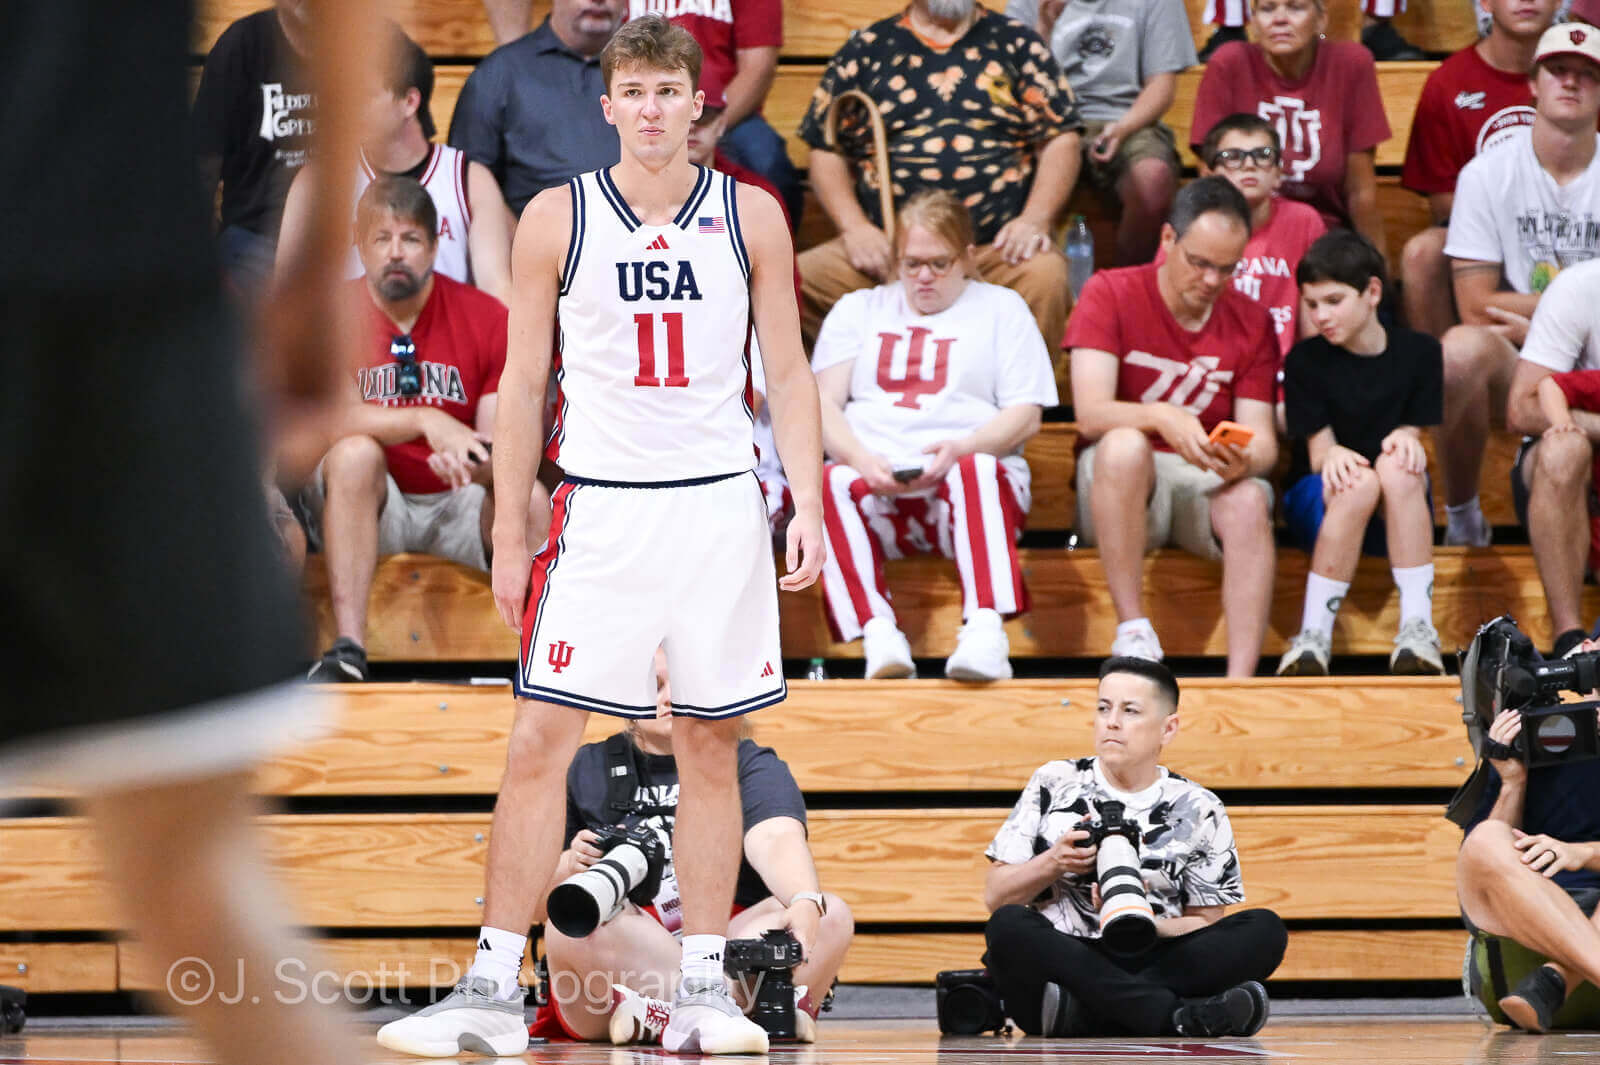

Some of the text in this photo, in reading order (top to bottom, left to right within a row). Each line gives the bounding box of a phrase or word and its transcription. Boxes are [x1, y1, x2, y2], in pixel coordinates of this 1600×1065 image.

[616, 260, 703, 301] USA
[634, 312, 690, 387] 11
[547, 640, 575, 673] IU
